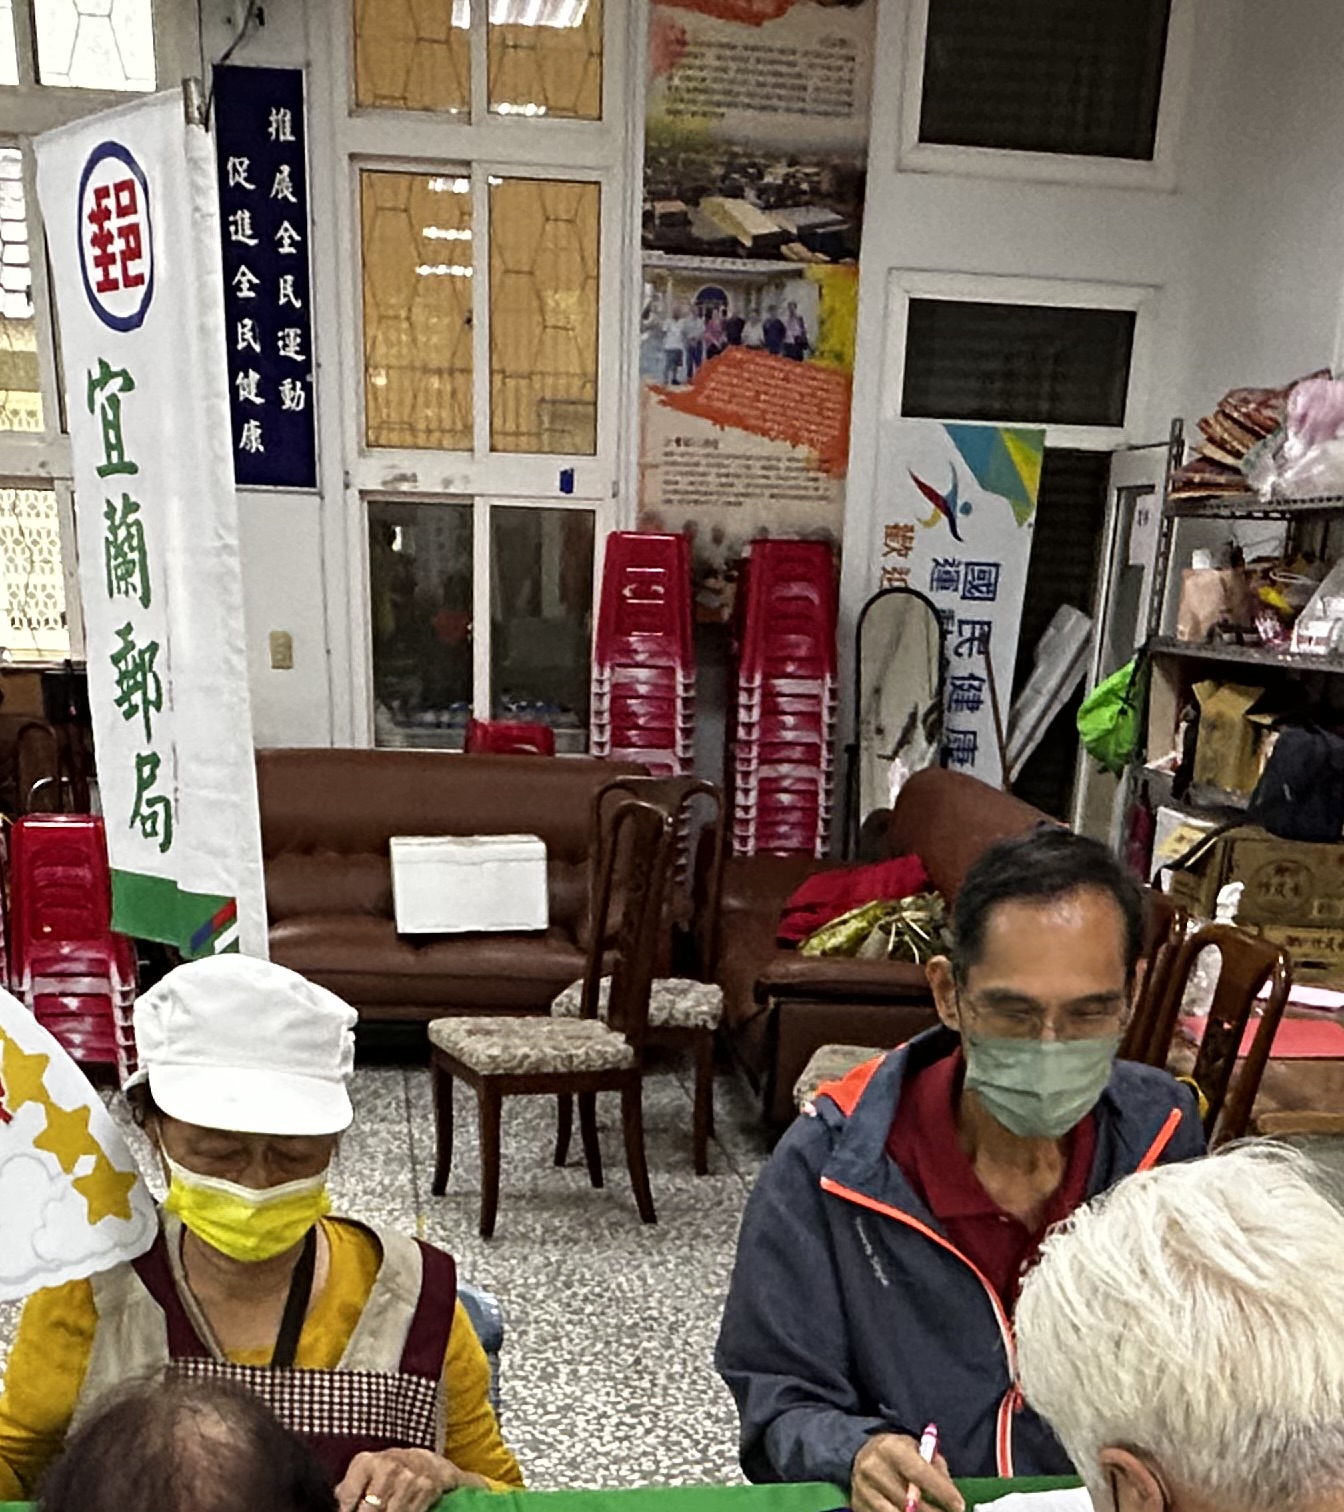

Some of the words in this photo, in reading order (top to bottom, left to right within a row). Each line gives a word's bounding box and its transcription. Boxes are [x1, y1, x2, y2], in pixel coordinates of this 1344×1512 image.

[87, 178, 145, 294] 郵
[226, 155, 266, 454] 促進全民健康
[267, 106, 307, 412] 推展全民運動
[87, 357, 173, 854] 宜蘭郵局
